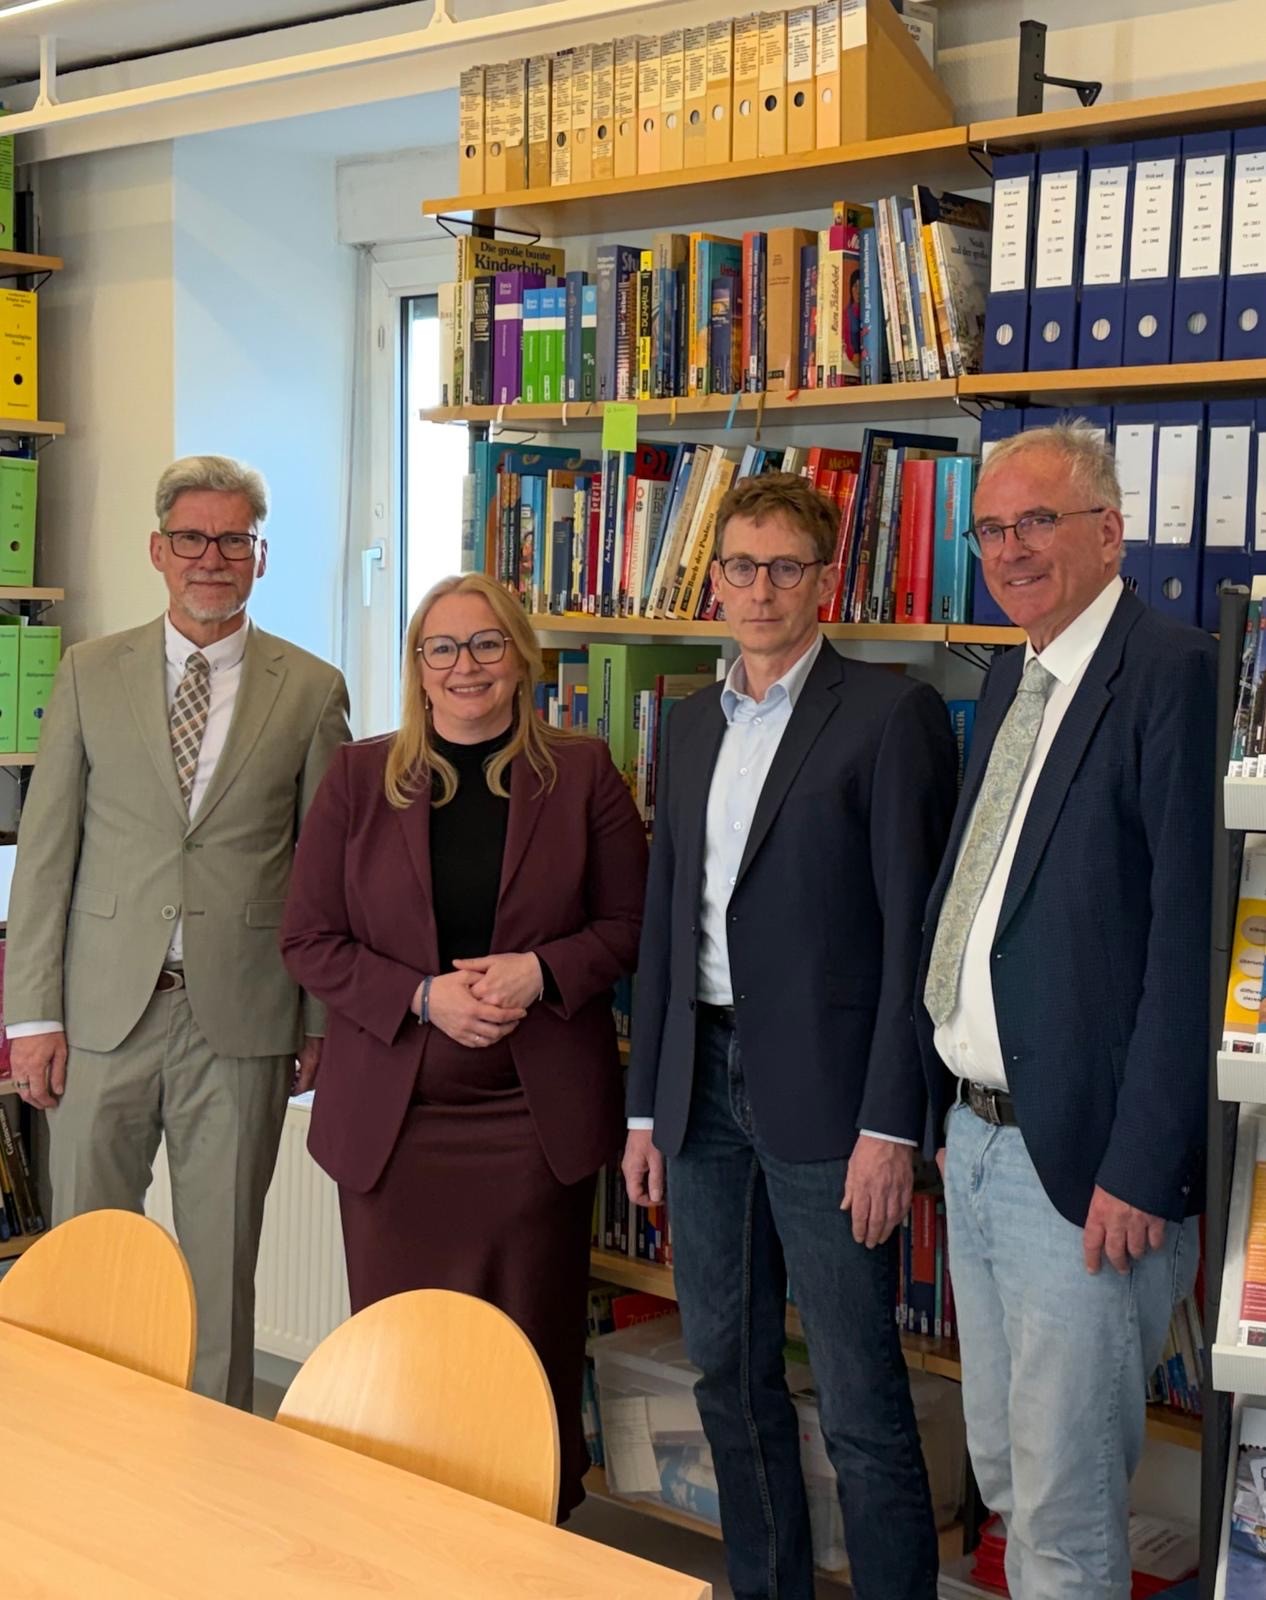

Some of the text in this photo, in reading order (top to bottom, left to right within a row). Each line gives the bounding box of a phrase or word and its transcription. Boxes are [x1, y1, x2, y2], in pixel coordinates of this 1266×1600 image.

[480, 241, 551, 260] Die große bunte
[475, 253, 556, 276] Kinderbibel
[687, 565, 700, 587] Buch
[695, 550, 704, 565] der
